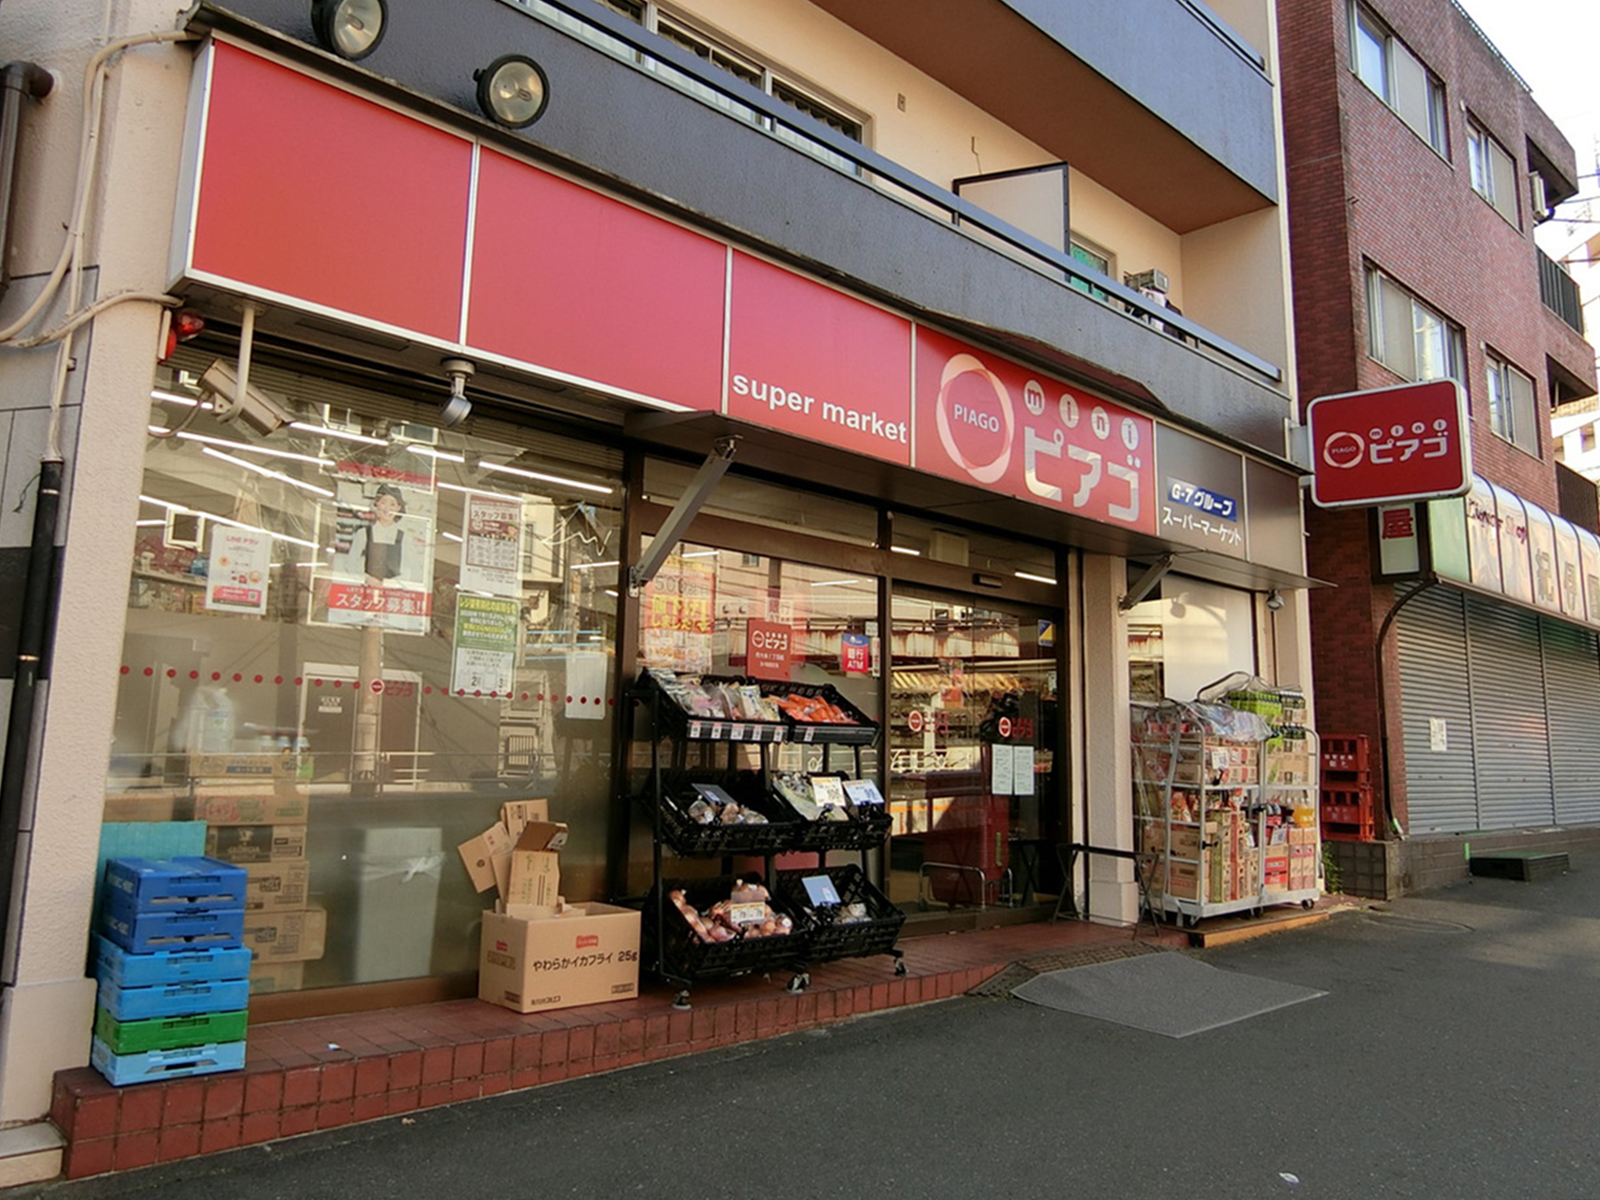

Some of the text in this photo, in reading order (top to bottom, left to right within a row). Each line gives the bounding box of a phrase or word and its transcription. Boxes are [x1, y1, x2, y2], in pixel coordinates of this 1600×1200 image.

[732, 371, 907, 445] super market
[952, 402, 1000, 433] PIAGO
[1023, 379, 1140, 450] mini
[1331, 445, 1356, 454] PIAGO
[1369, 431, 1449, 464] ピアゴ
[1023, 425, 1143, 523] ピアゴ
[1162, 505, 1242, 547] スーパーマーケット
[765, 638, 788, 651] ピアゴ
[847, 648, 864, 659] 銀行
[847, 660, 864, 669] ATM
[532, 950, 639, 973] やわらかイカフライ 25g
